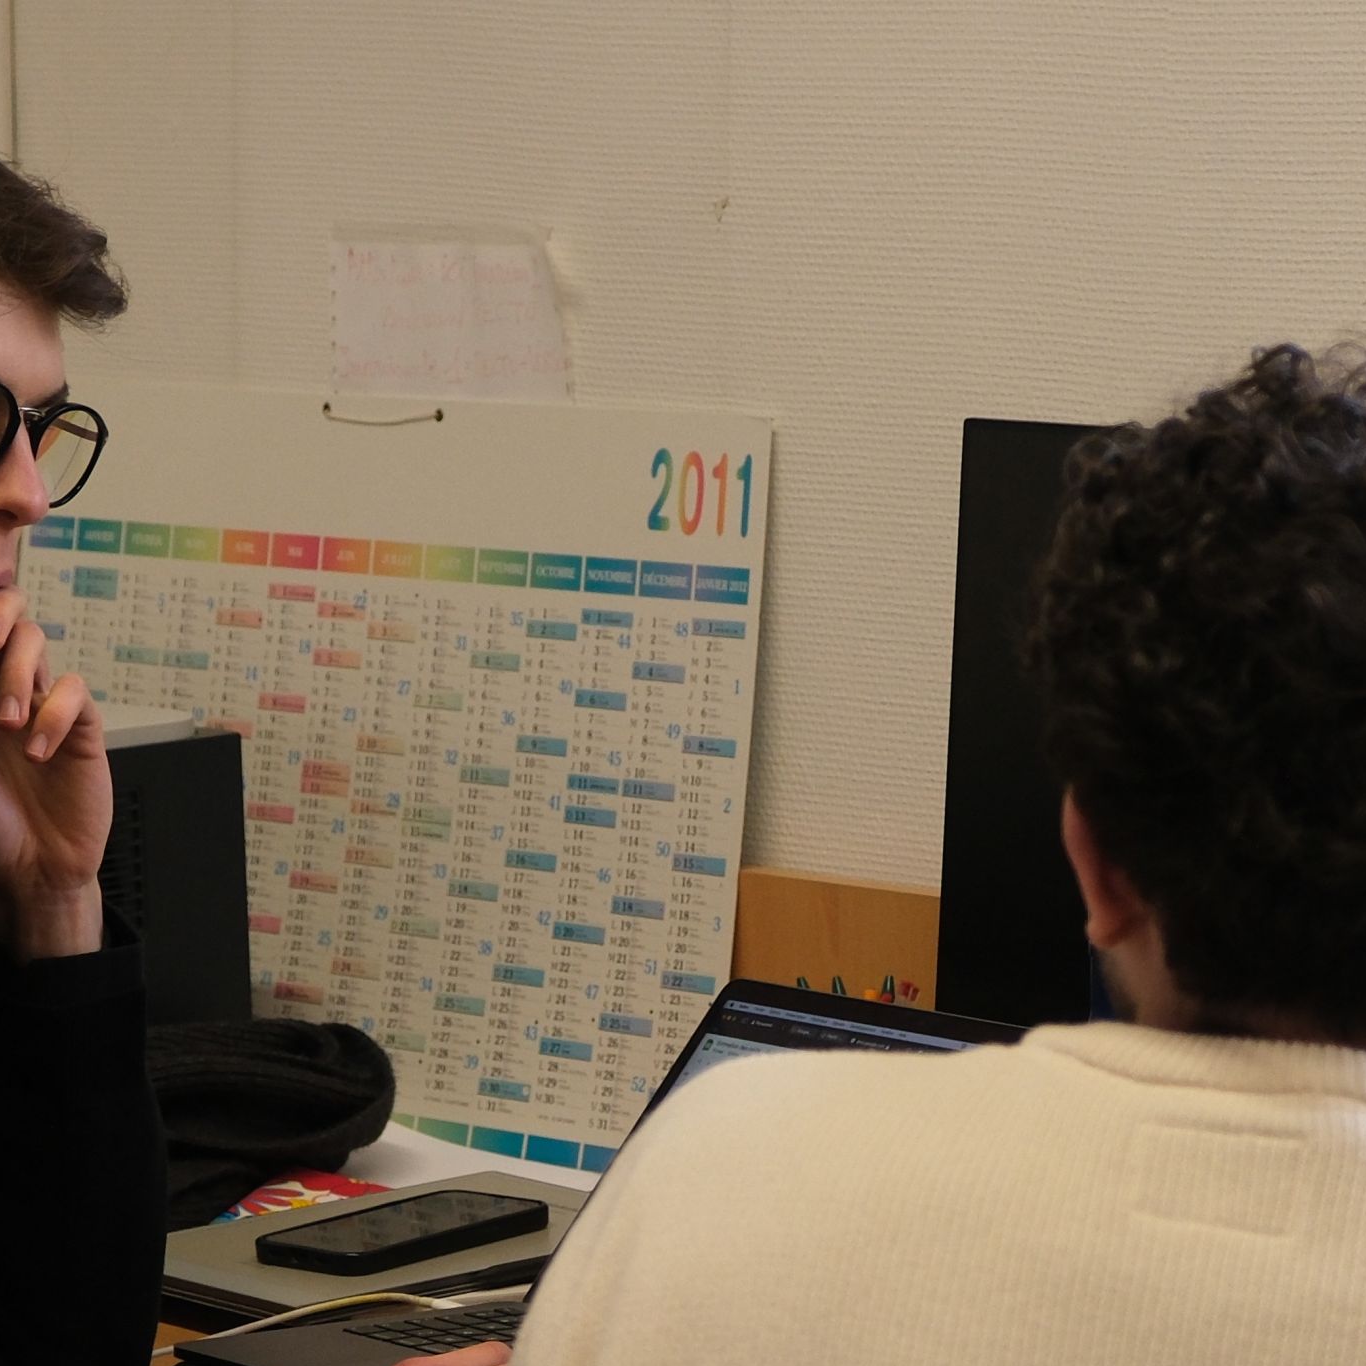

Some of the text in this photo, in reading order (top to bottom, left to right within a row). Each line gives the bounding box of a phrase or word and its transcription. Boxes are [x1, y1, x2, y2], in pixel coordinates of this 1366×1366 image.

[647, 448, 753, 538] 2011
[535, 564, 576, 579] OCTOBRE
[587, 569, 634, 584] NOVEMBRE
[667, 722, 681, 739] 49
[607, 750, 622, 767] 45
[634, 767, 646, 779] 10
[690, 775, 702, 787] 10
[632, 783, 643, 796] 11
[688, 791, 699, 804] 11
[631, 802, 643, 815] 12
[722, 798, 732, 813] 2
[687, 807, 699, 820] 12
[686, 824, 698, 837] 13
[656, 841, 671, 857] 50
[684, 841, 696, 853] 14
[626, 851, 638, 864] 15
[683, 857, 695, 870] 15
[596, 868, 611, 883] 46
[625, 868, 637, 880] 16
[681, 876, 693, 889] 16
[623, 884, 635, 897] 17
[680, 893, 691, 905] 17
[678, 909, 690, 921] 18
[620, 919, 632, 932] 19
[714, 915, 722, 932] 3
[676, 925, 689, 938] 19
[674, 942, 687, 954] 20
[616, 952, 627, 965] 21
[672, 958, 684, 971] 21
[644, 959, 657, 976] 51
[614, 969, 627, 981] 22
[671, 975, 684, 988] 22
[585, 983, 599, 999] 47
[612, 985, 625, 997] 23
[669, 994, 681, 1006] 23
[611, 1002, 623, 1014] 24
[667, 1010, 679, 1022] 24
[665, 1027, 678, 1039] 25
[606, 1036, 619, 1048] 26
[604, 1053, 617, 1065] 27
[631, 1076, 646, 1093] 52
[601, 1086, 614, 1097] 29
[597, 1118, 608, 1131] 31
